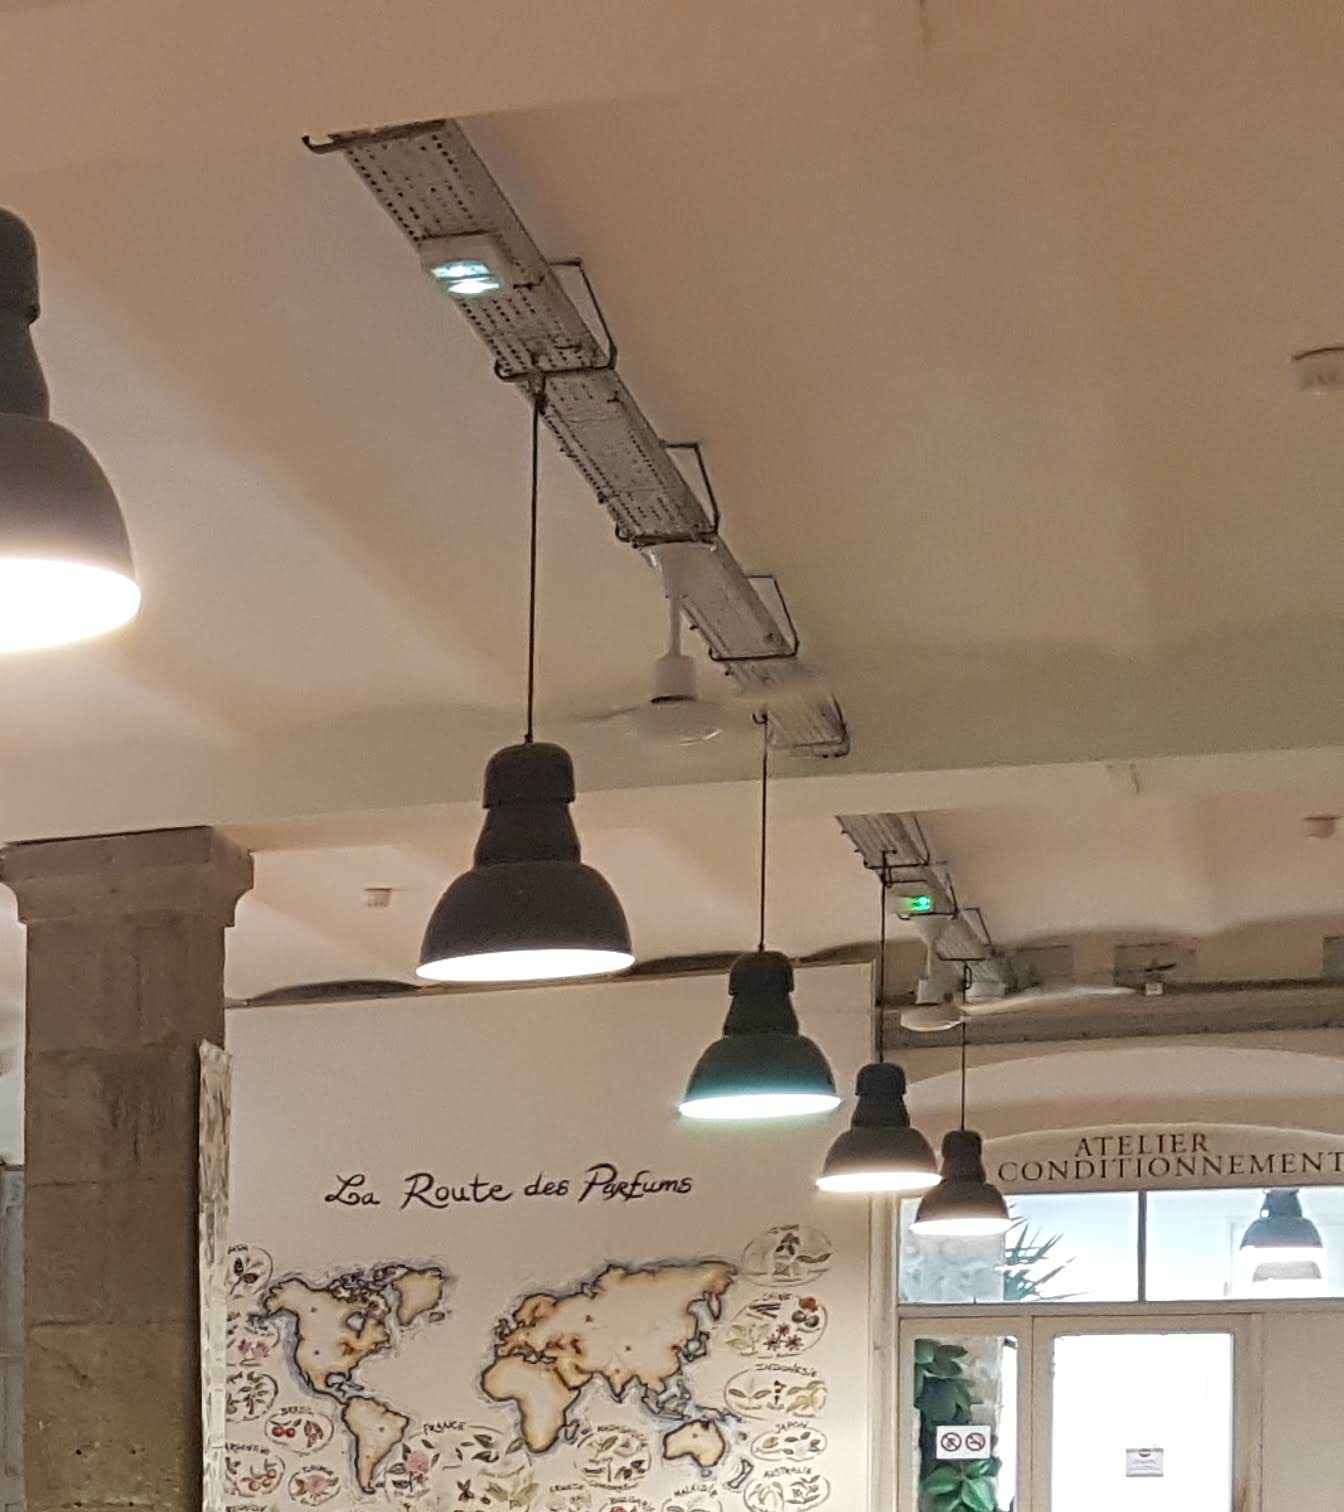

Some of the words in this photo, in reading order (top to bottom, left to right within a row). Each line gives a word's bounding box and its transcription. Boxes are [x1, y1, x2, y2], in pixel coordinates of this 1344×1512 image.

[1074, 1133, 1210, 1157] ATELIER
[998, 1151, 1344, 1182] CONDITIONNEMENT
[324, 1174, 380, 1206] La
[400, 1172, 512, 1209] Route
[524, 1172, 569, 1196] des
